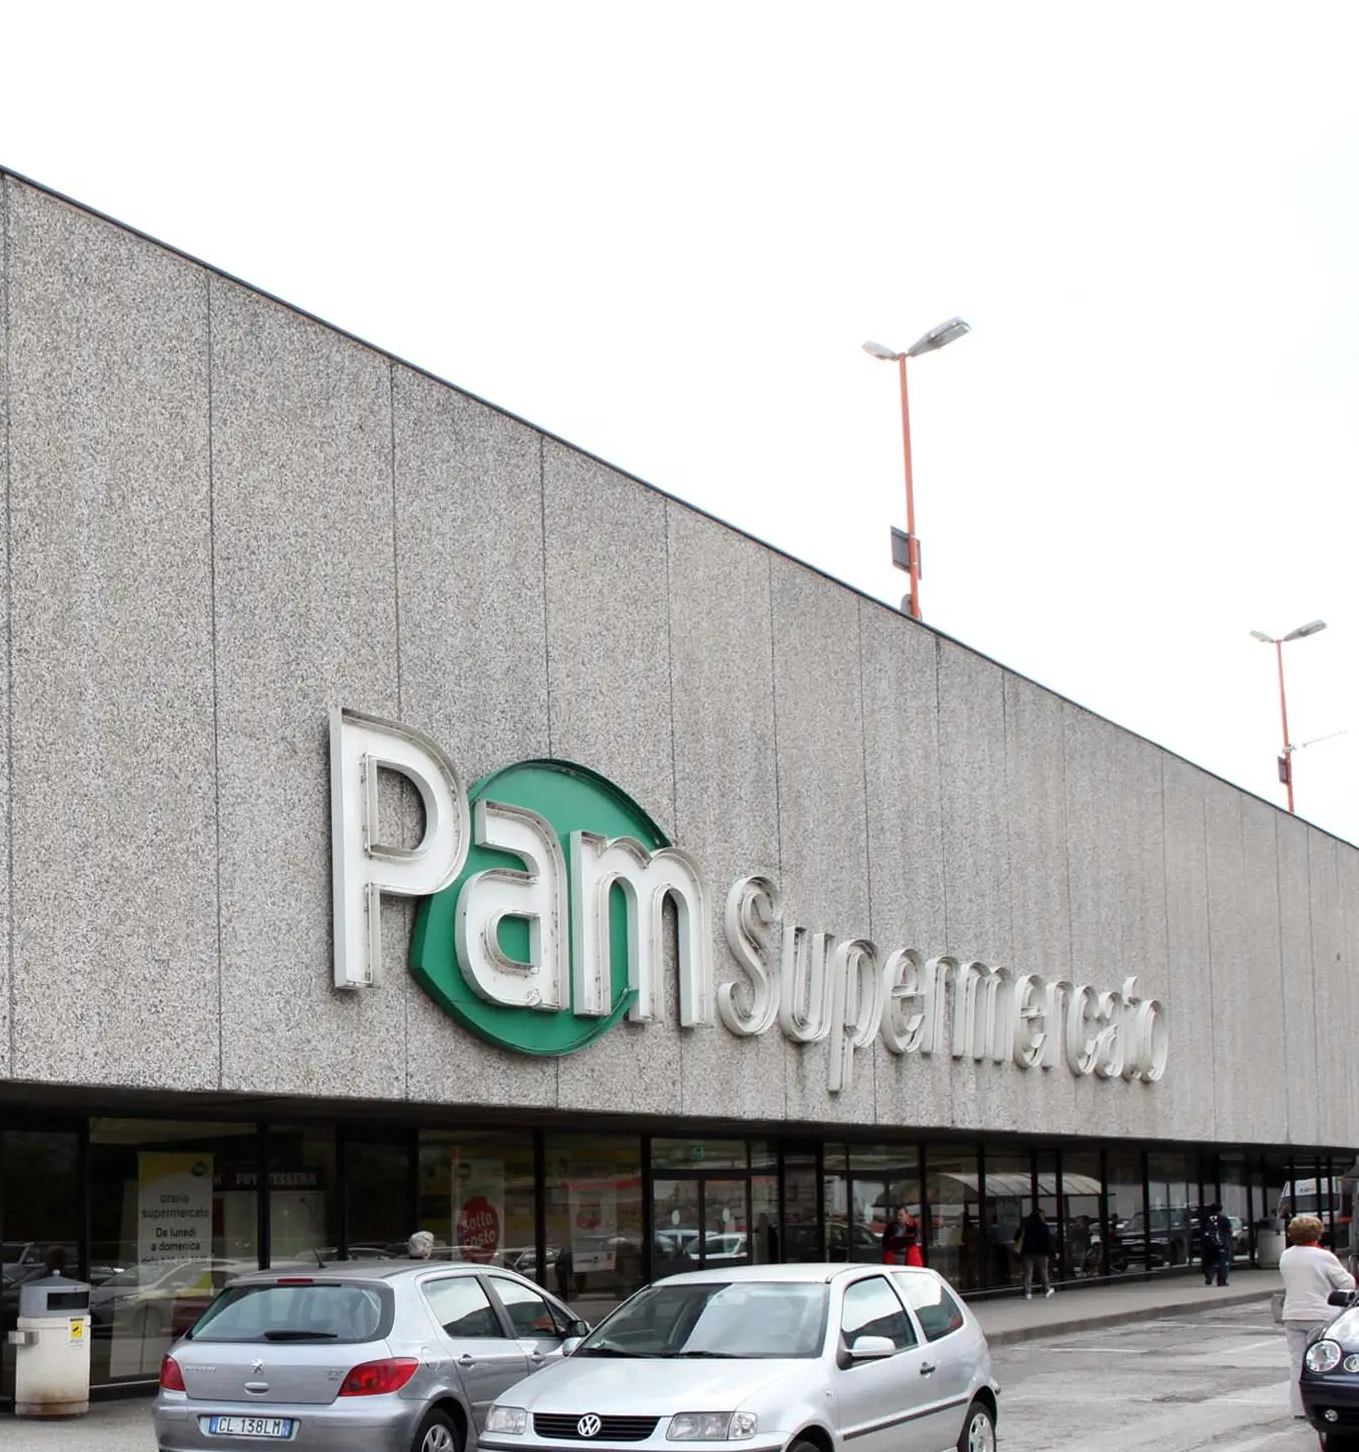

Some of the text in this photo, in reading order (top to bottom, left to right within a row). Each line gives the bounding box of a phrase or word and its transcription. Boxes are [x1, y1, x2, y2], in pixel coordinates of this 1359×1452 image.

[329, 706, 1169, 1093] Pam Supermercato
[141, 1206, 209, 1221] supermercato
[156, 1227, 167, 1237] Da
[151, 1242, 200, 1251] a domenica
